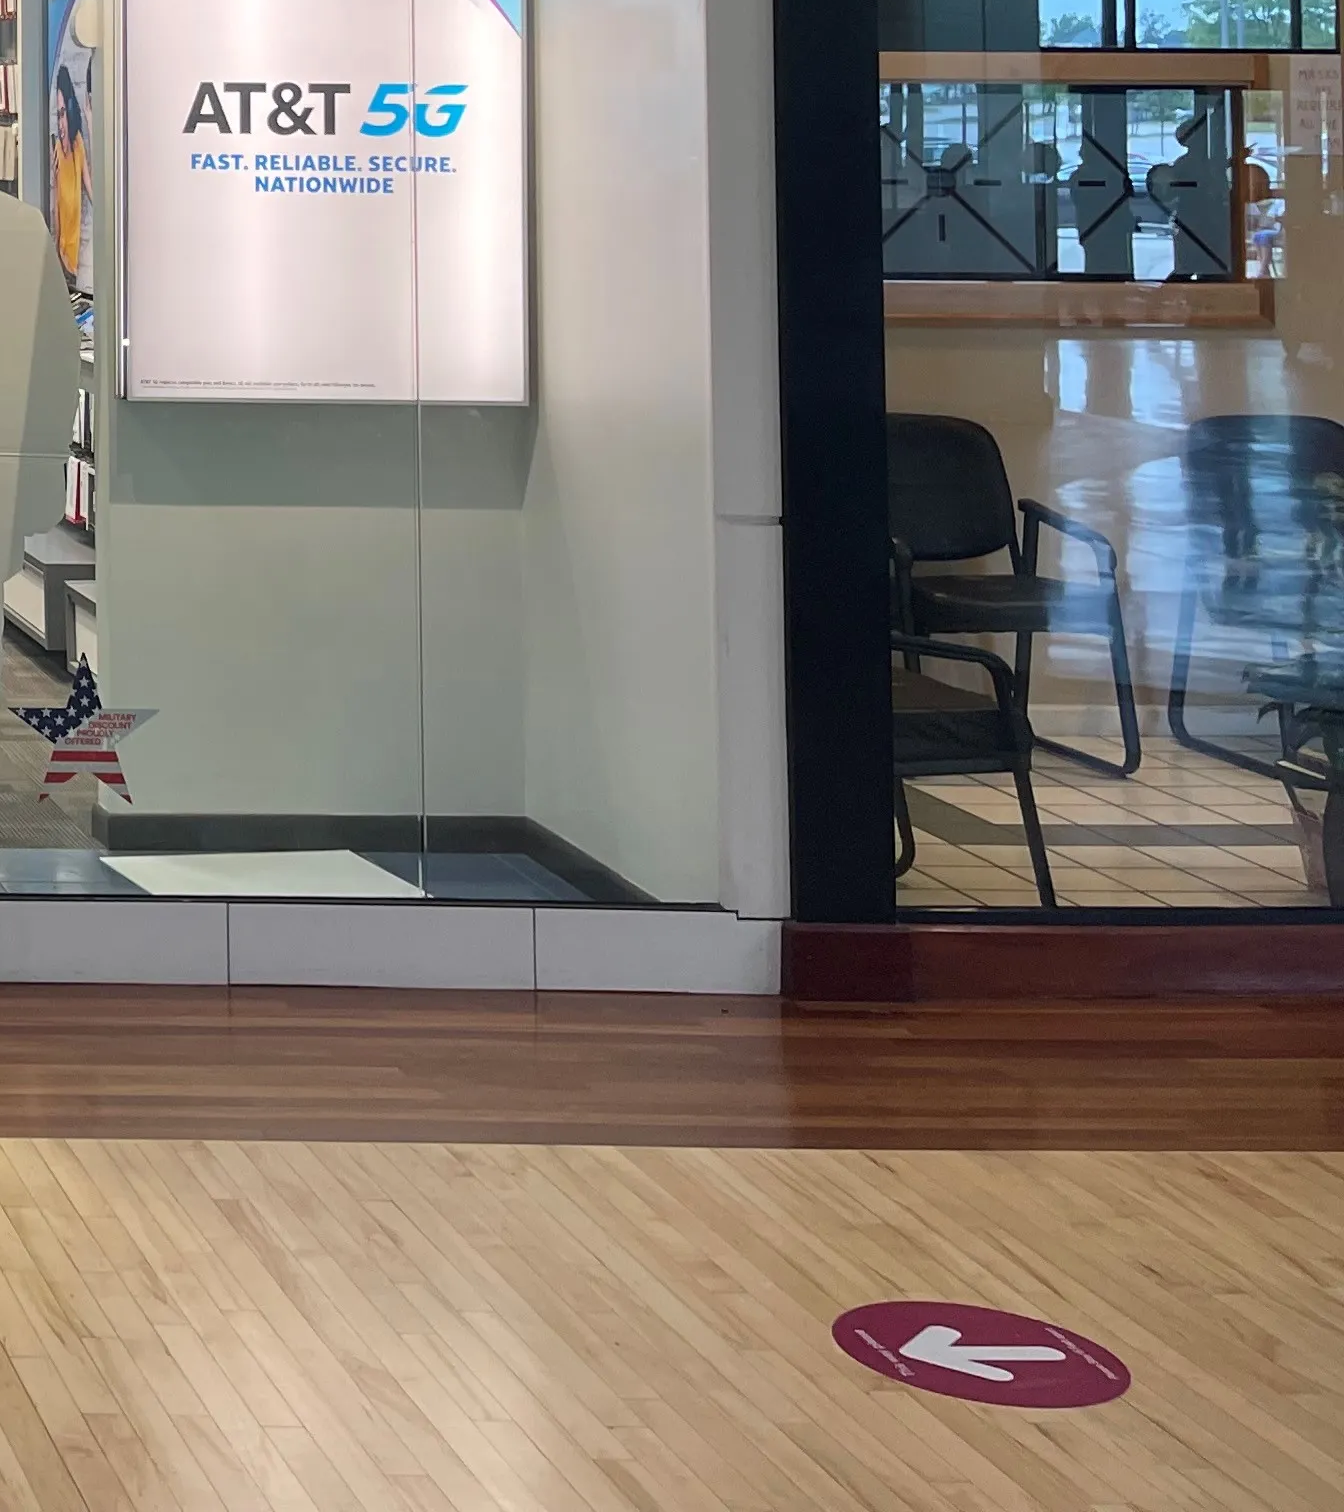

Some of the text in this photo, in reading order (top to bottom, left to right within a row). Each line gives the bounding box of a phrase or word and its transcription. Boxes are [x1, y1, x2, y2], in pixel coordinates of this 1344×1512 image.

[182, 81, 469, 138] AT&T 5G
[190, 153, 457, 173] FAST. RELIABLE. SECURE.
[255, 176, 394, 194] NATIONWIDE
